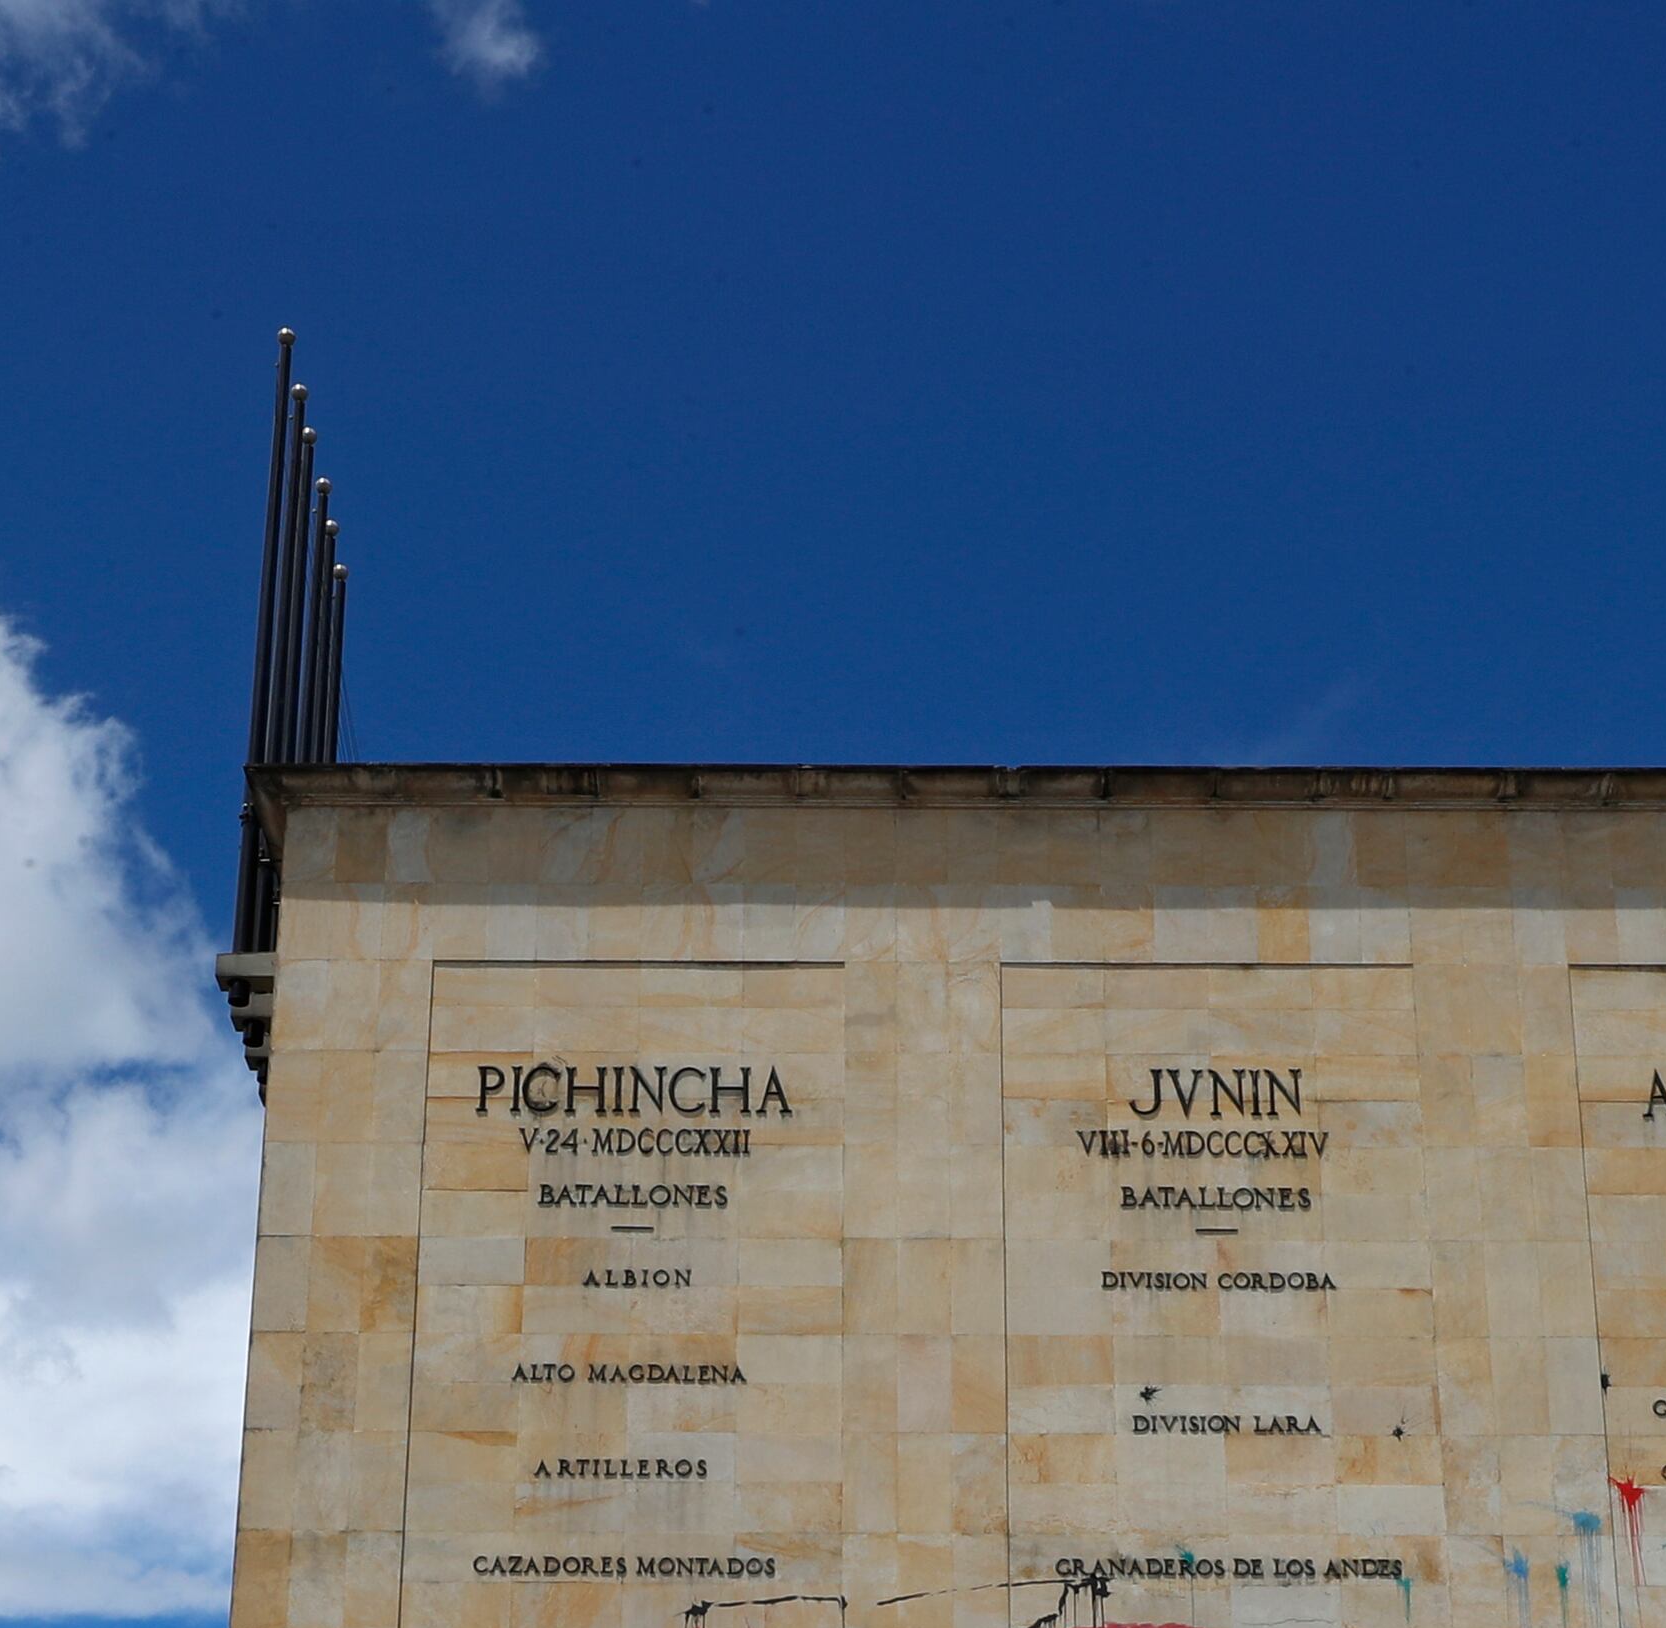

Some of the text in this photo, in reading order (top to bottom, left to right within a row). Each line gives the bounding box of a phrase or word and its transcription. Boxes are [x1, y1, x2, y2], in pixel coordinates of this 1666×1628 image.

[475, 1065, 793, 1117] PICHINCHA
[1129, 1068, 1303, 1119] JVNIN
[538, 1184, 729, 1207] BATALLONES
[1121, 1186, 1312, 1210] BATALLONES
[583, 1269, 692, 1288] ALBION
[1101, 1272, 1336, 1291] DIVISION CORDOBA
[512, 1364, 747, 1384] ALTO MAGDALENA
[1133, 1416, 1322, 1434] DIVISION LARA
[534, 1459, 708, 1479] ARTILLEROS
[473, 1556, 776, 1578] CAZADORES MONTADOS
[1055, 1558, 1403, 1579] GRANADEROS DE LOS ANDES
